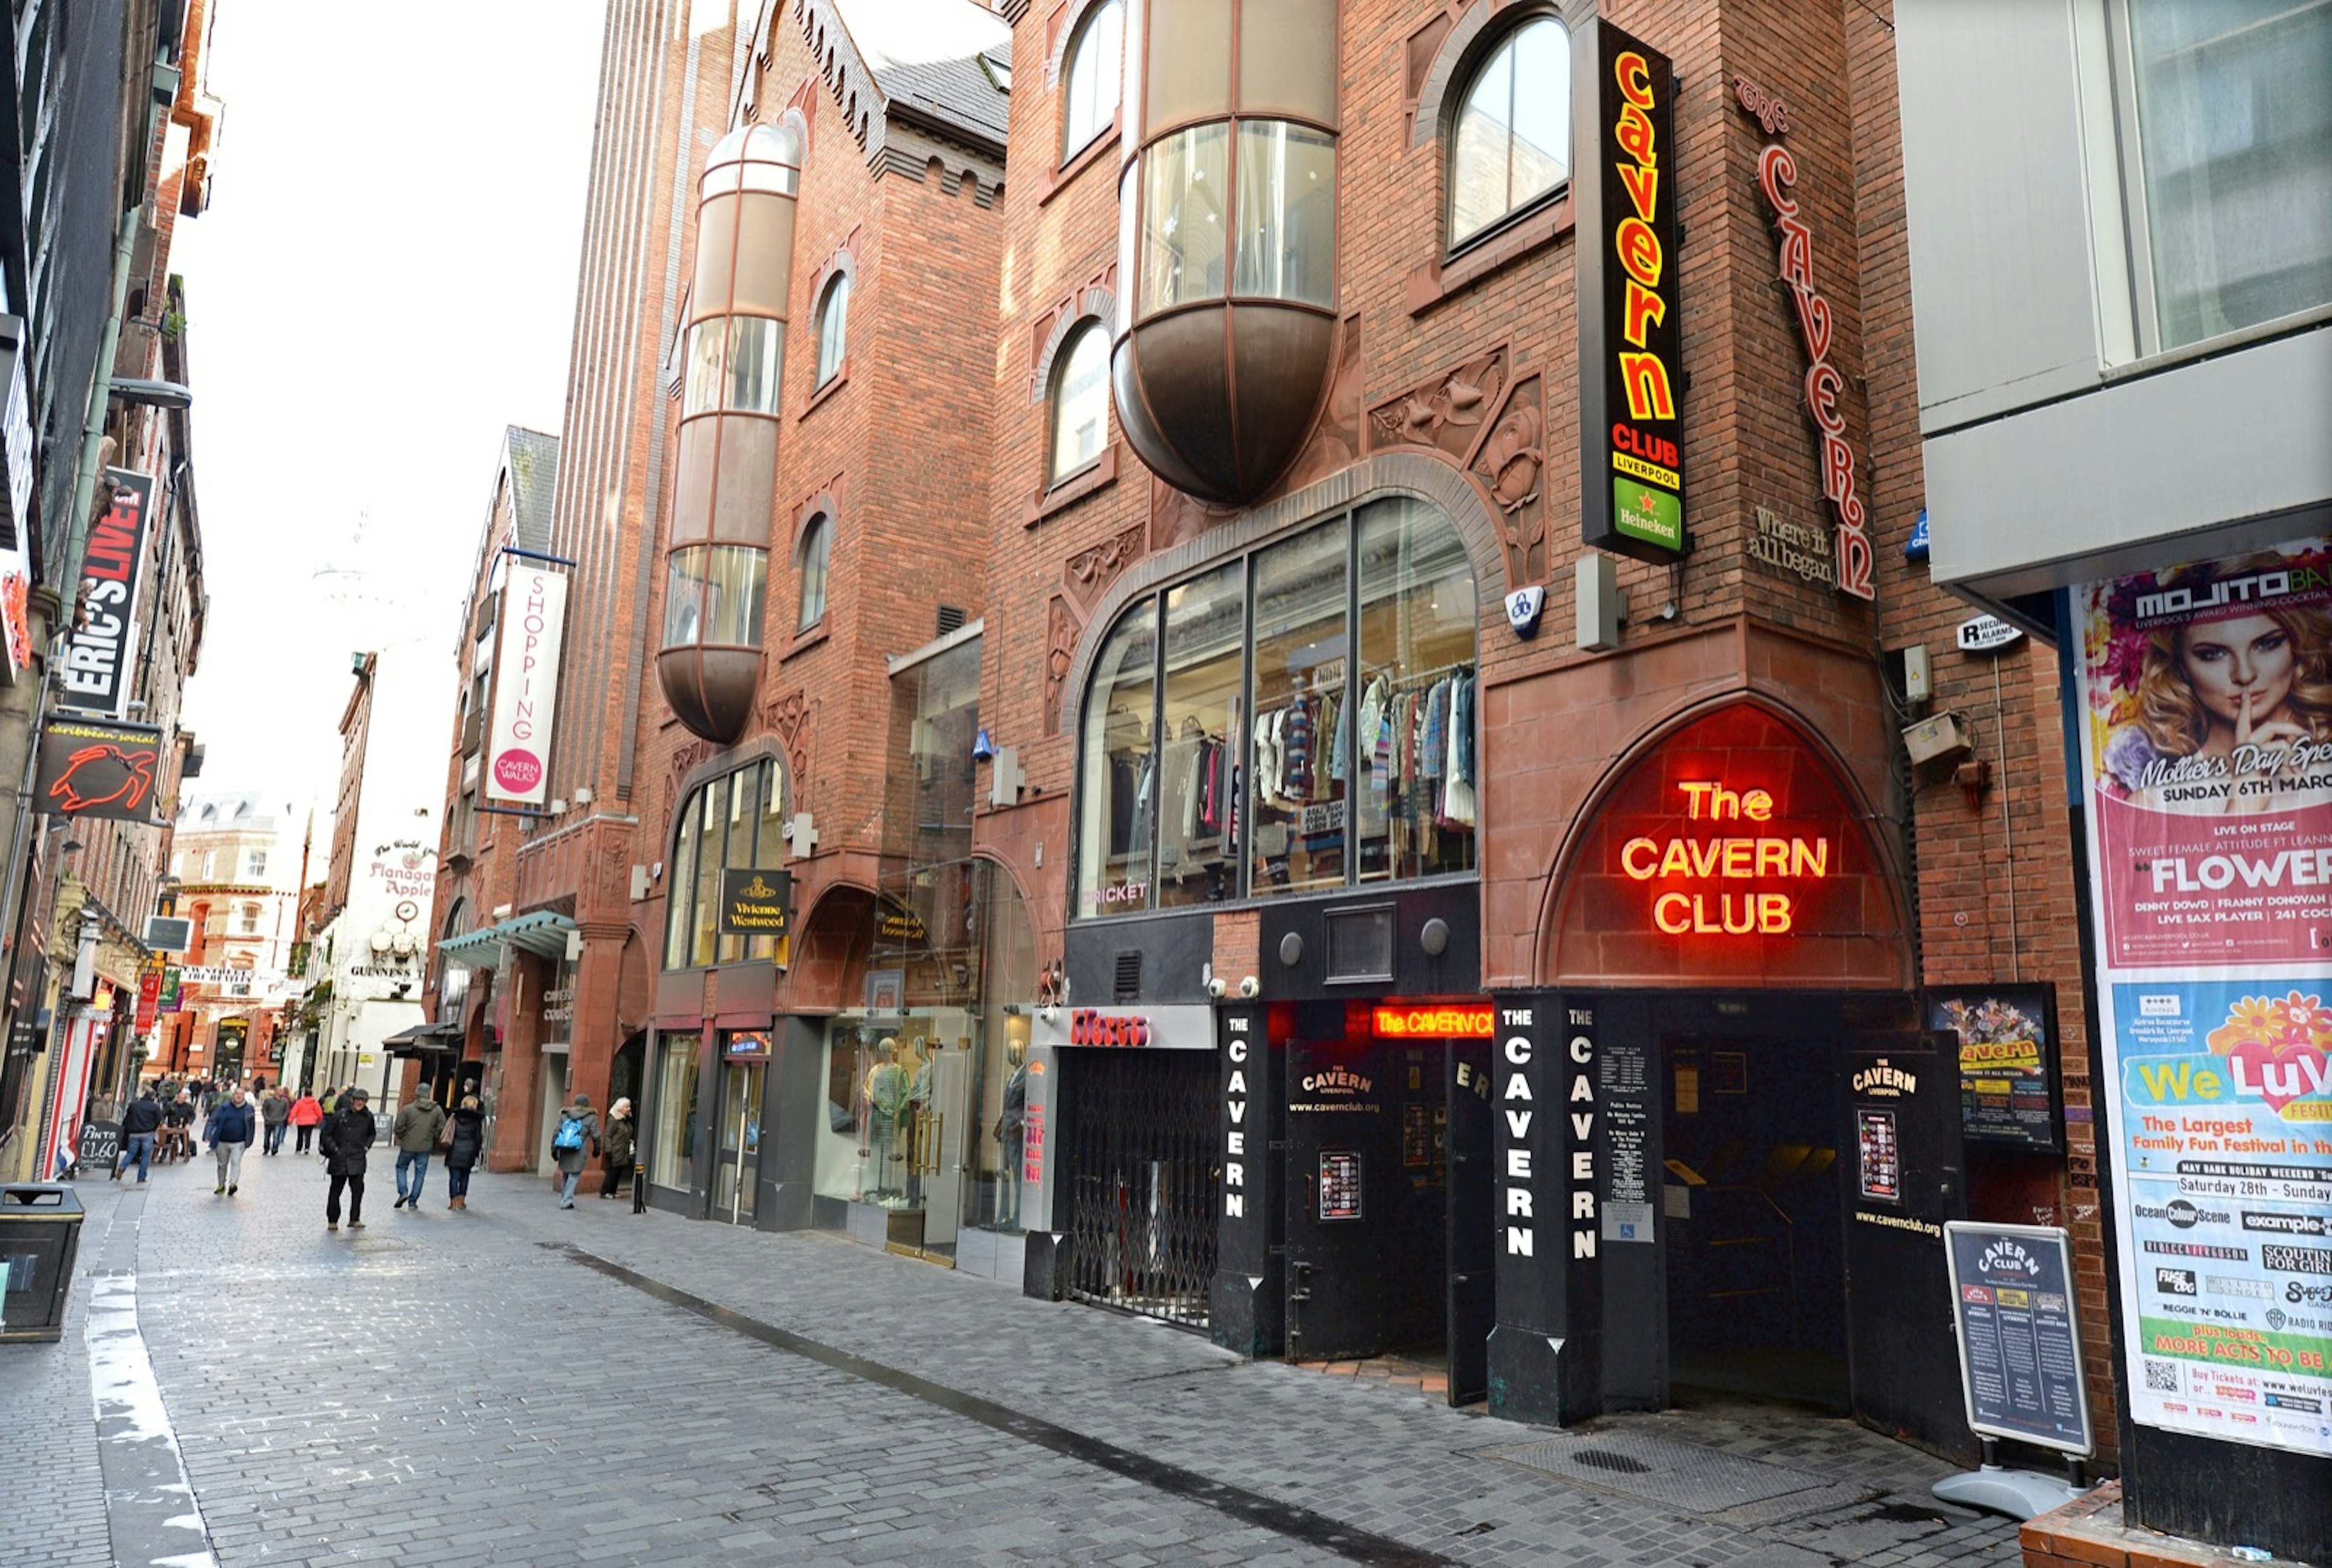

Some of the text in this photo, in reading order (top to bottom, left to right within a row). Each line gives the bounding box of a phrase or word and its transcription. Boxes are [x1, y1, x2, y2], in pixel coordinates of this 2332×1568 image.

[1612, 423, 1679, 468] CLUB
[1617, 458, 1677, 486] LIVERPOOL
[1620, 508, 1676, 539] Heineken
[1755, 505, 1829, 556] Where it
[1746, 536, 1833, 583] all began
[2136, 564, 2332, 618] MOJITO BA
[2193, 608, 2227, 619] AWARD
[2229, 600, 2277, 614] WINNING
[1963, 625, 1979, 643] R
[512, 576, 545, 740] SHOPPING
[498, 759, 539, 773] CAVERN
[2232, 744, 2285, 775] Day
[501, 767, 536, 783] WALKS
[1678, 782, 1773, 820] The
[2163, 783, 2232, 802] SUNDAY
[2239, 780, 2272, 796] 6TH
[2214, 821, 2296, 836] LIVE ON STAGE
[2129, 847, 2164, 857] SWEET
[2168, 842, 2211, 854] FEMALE
[2215, 837, 2270, 851] ATTITUDE
[1621, 837, 1827, 880] CAVERN
[386, 880, 432, 897] Apple
[1082, 882, 1148, 905] CRICKET
[1654, 891, 1792, 934] CLUB
[2135, 893, 2326, 912] DENNY DOWD FRANNY DONOVAN
[729, 913, 784, 928] Westwood
[2158, 914, 2183, 924] LIVE
[2187, 912, 2211, 923] SAX
[2215, 910, 2264, 922] PLAYER
[2275, 910, 2296, 920] 241
[351, 966, 411, 978] GUINNESS
[1228, 1017, 1249, 1032] THE
[1407, 1011, 1475, 1032] CAVERN
[1502, 1009, 1533, 1026] THE
[1569, 1009, 1592, 1026] THE
[1302, 1071, 1372, 1092] CAVERN
[1853, 1067, 1917, 1094] CAVERN
[2139, 1062, 2221, 1102] We
[1289, 1102, 1380, 1114] www.cavernclub.org
[1226, 1040, 1248, 1218] CAVERN
[2142, 1116, 2253, 1137] The Largest
[81, 1140, 119, 1158] £1.60
[1504, 1036, 1533, 1257] CAVERN
[1570, 1036, 1597, 1259] CAVERN
[2133, 1136, 2184, 1153] Family
[2189, 1137, 2218, 1151] Fun
[2224, 1137, 2286, 1153] Festival
[2291, 1139, 2308, 1154] in
[2229, 1166, 2267, 1176] HOLIDAY
[2271, 1168, 2314, 1179] WEEKEND
[2180, 1178, 2236, 1196] Saturday
[2240, 1181, 2267, 1195] 28th
[2283, 1184, 2331, 1202] Sunday
[2135, 1204, 2166, 1218] Ocean
[2198, 1208, 2231, 1224] Scene
[1855, 1211, 1941, 1238] www.cavernclub.org
[1979, 1241, 2040, 1276] CAVERN
[1994, 1259, 2022, 1270] CLUB
[2267, 1256, 2296, 1270] FOR
[2158, 1269, 2187, 1283] FUSE
[2163, 1304, 2197, 1315] REGGIE
[2214, 1310, 2247, 1320] BOLLIE
[2193, 1324, 2221, 1338] plus
[2288, 1317, 2316, 1329] RADIO
[2156, 1335, 2324, 1369] MORE ACTS TO BE
[2211, 1371, 2245, 1385] Tickets
